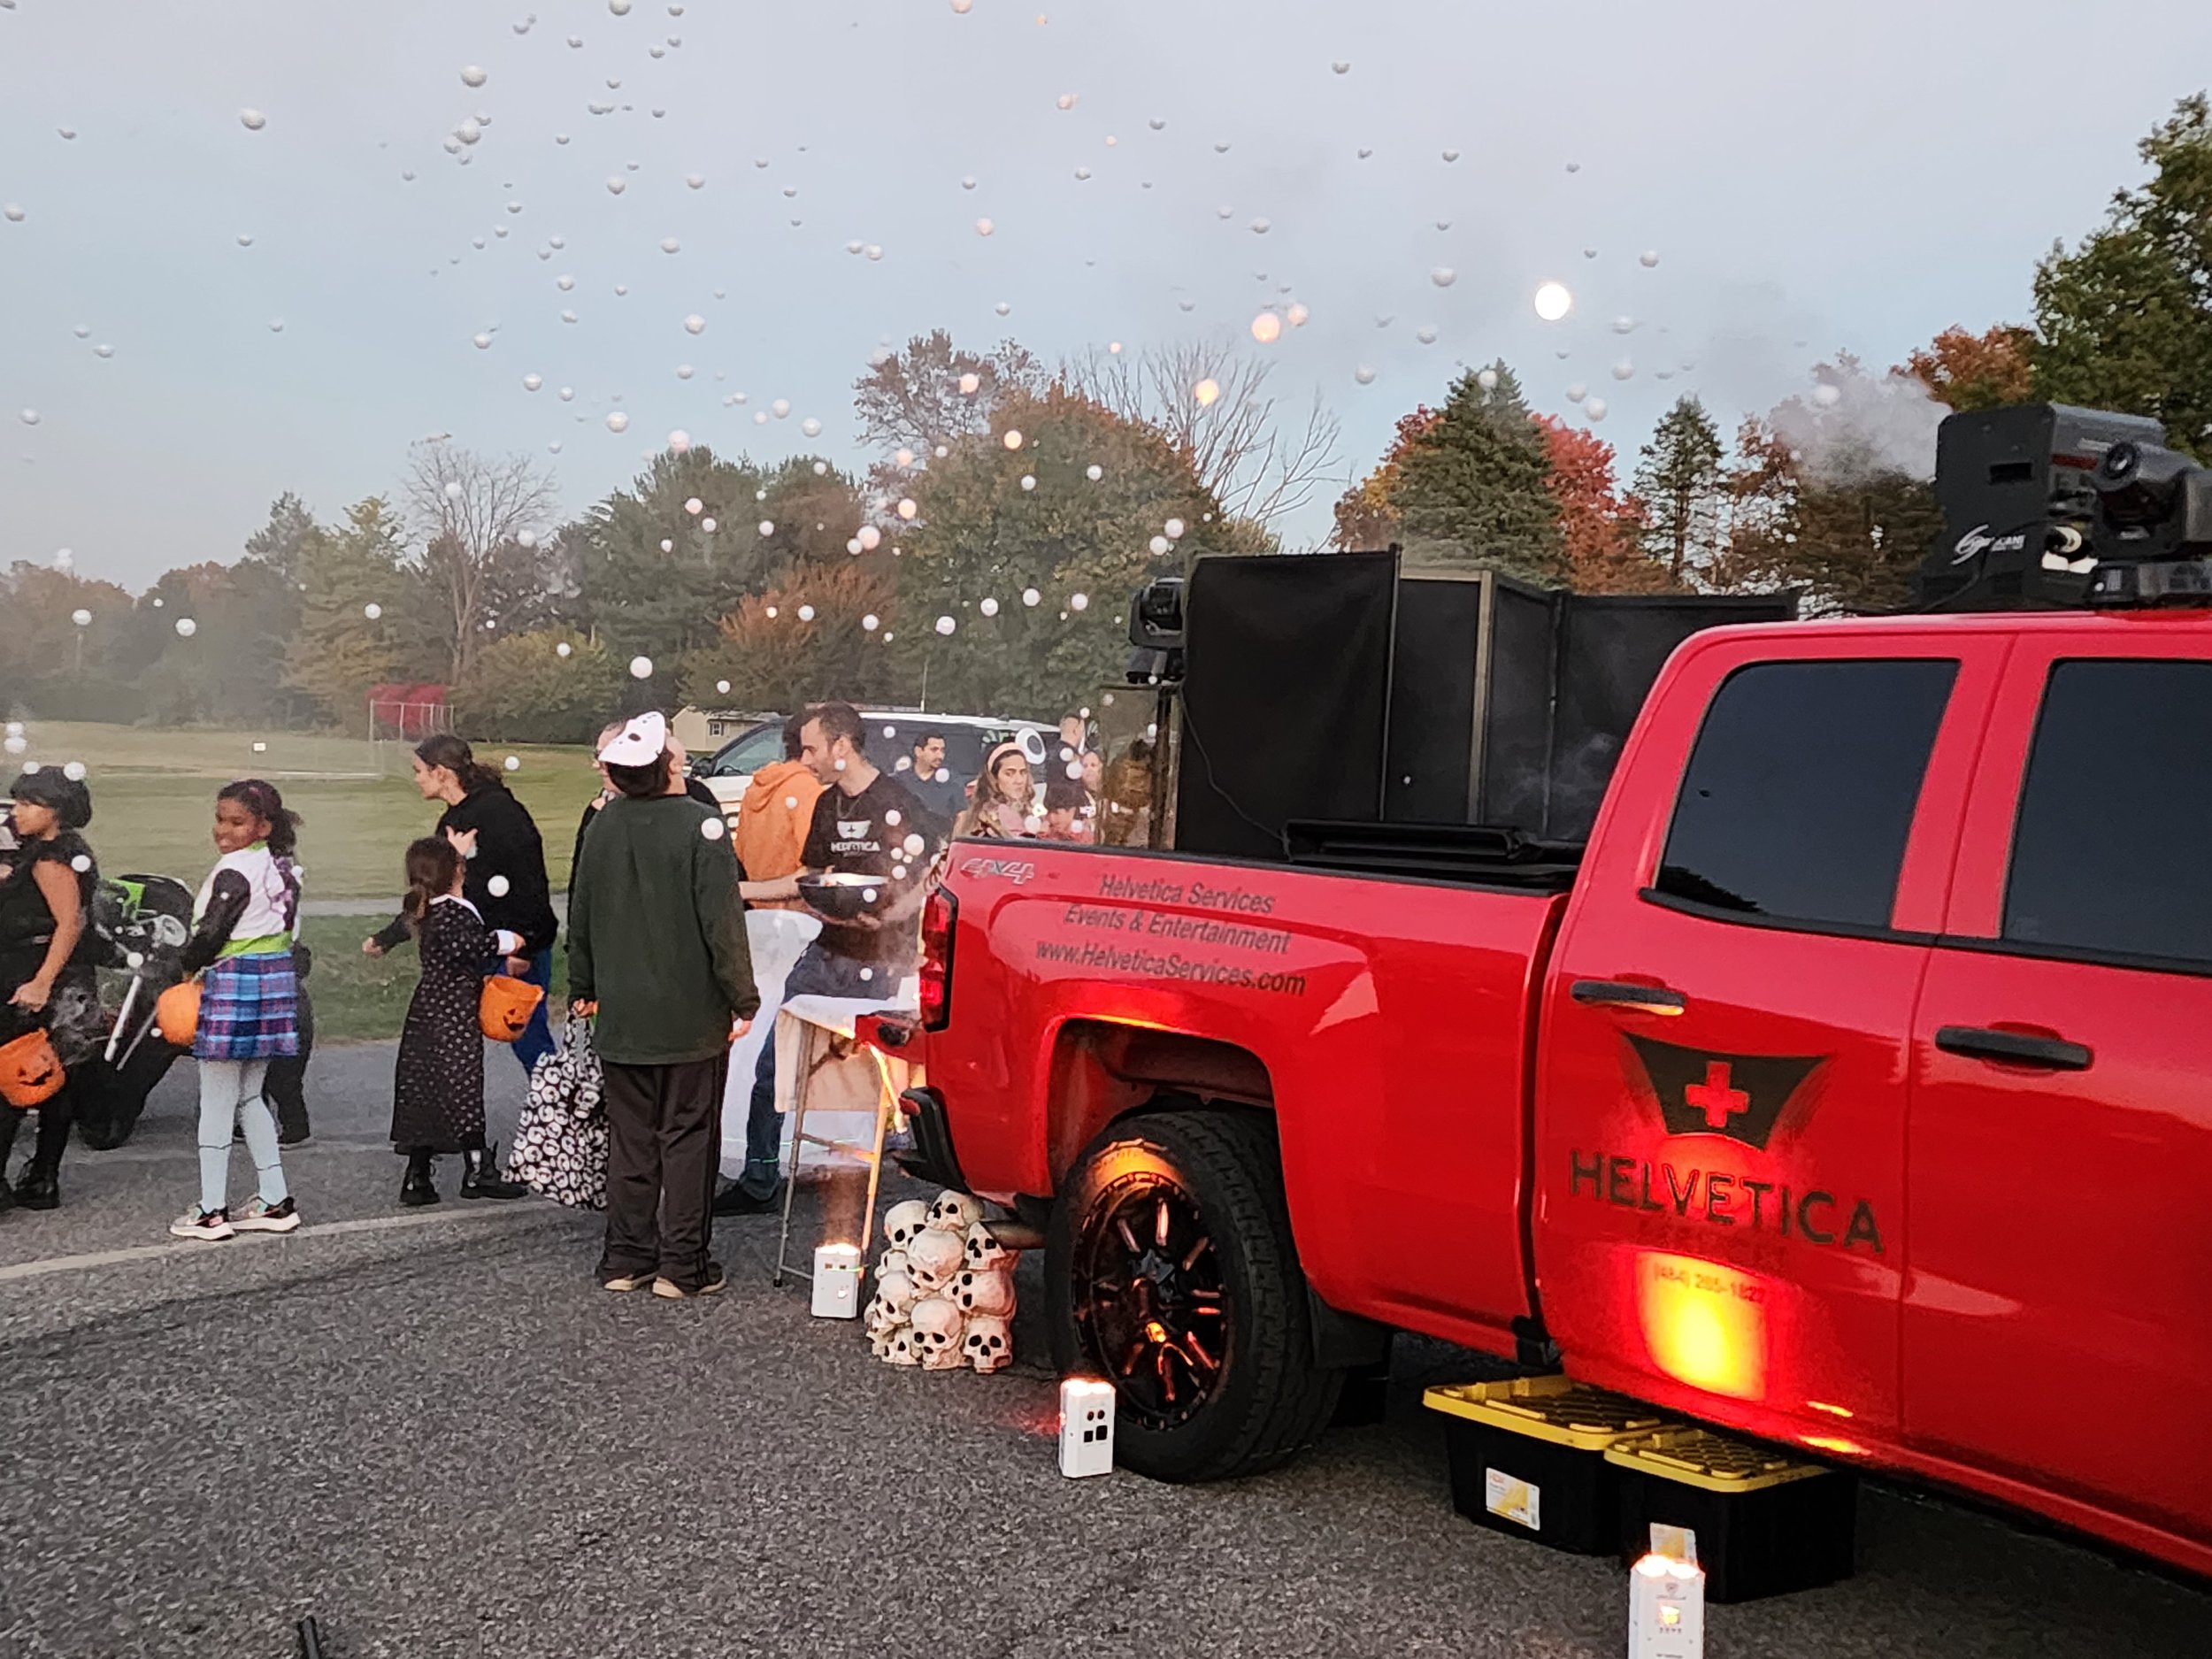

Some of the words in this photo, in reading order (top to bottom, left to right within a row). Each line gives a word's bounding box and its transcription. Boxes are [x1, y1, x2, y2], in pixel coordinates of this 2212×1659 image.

[1099, 873, 1183, 902] Helvetica
[1187, 881, 1275, 914] Services
[1064, 902, 1127, 929] Events
[1129, 908, 1144, 932] &
[1148, 912, 1291, 954] Entertainment
[1035, 941, 1306, 995] www.HelveticaServices.com
[1570, 1149, 1884, 1254] HELVETICA
